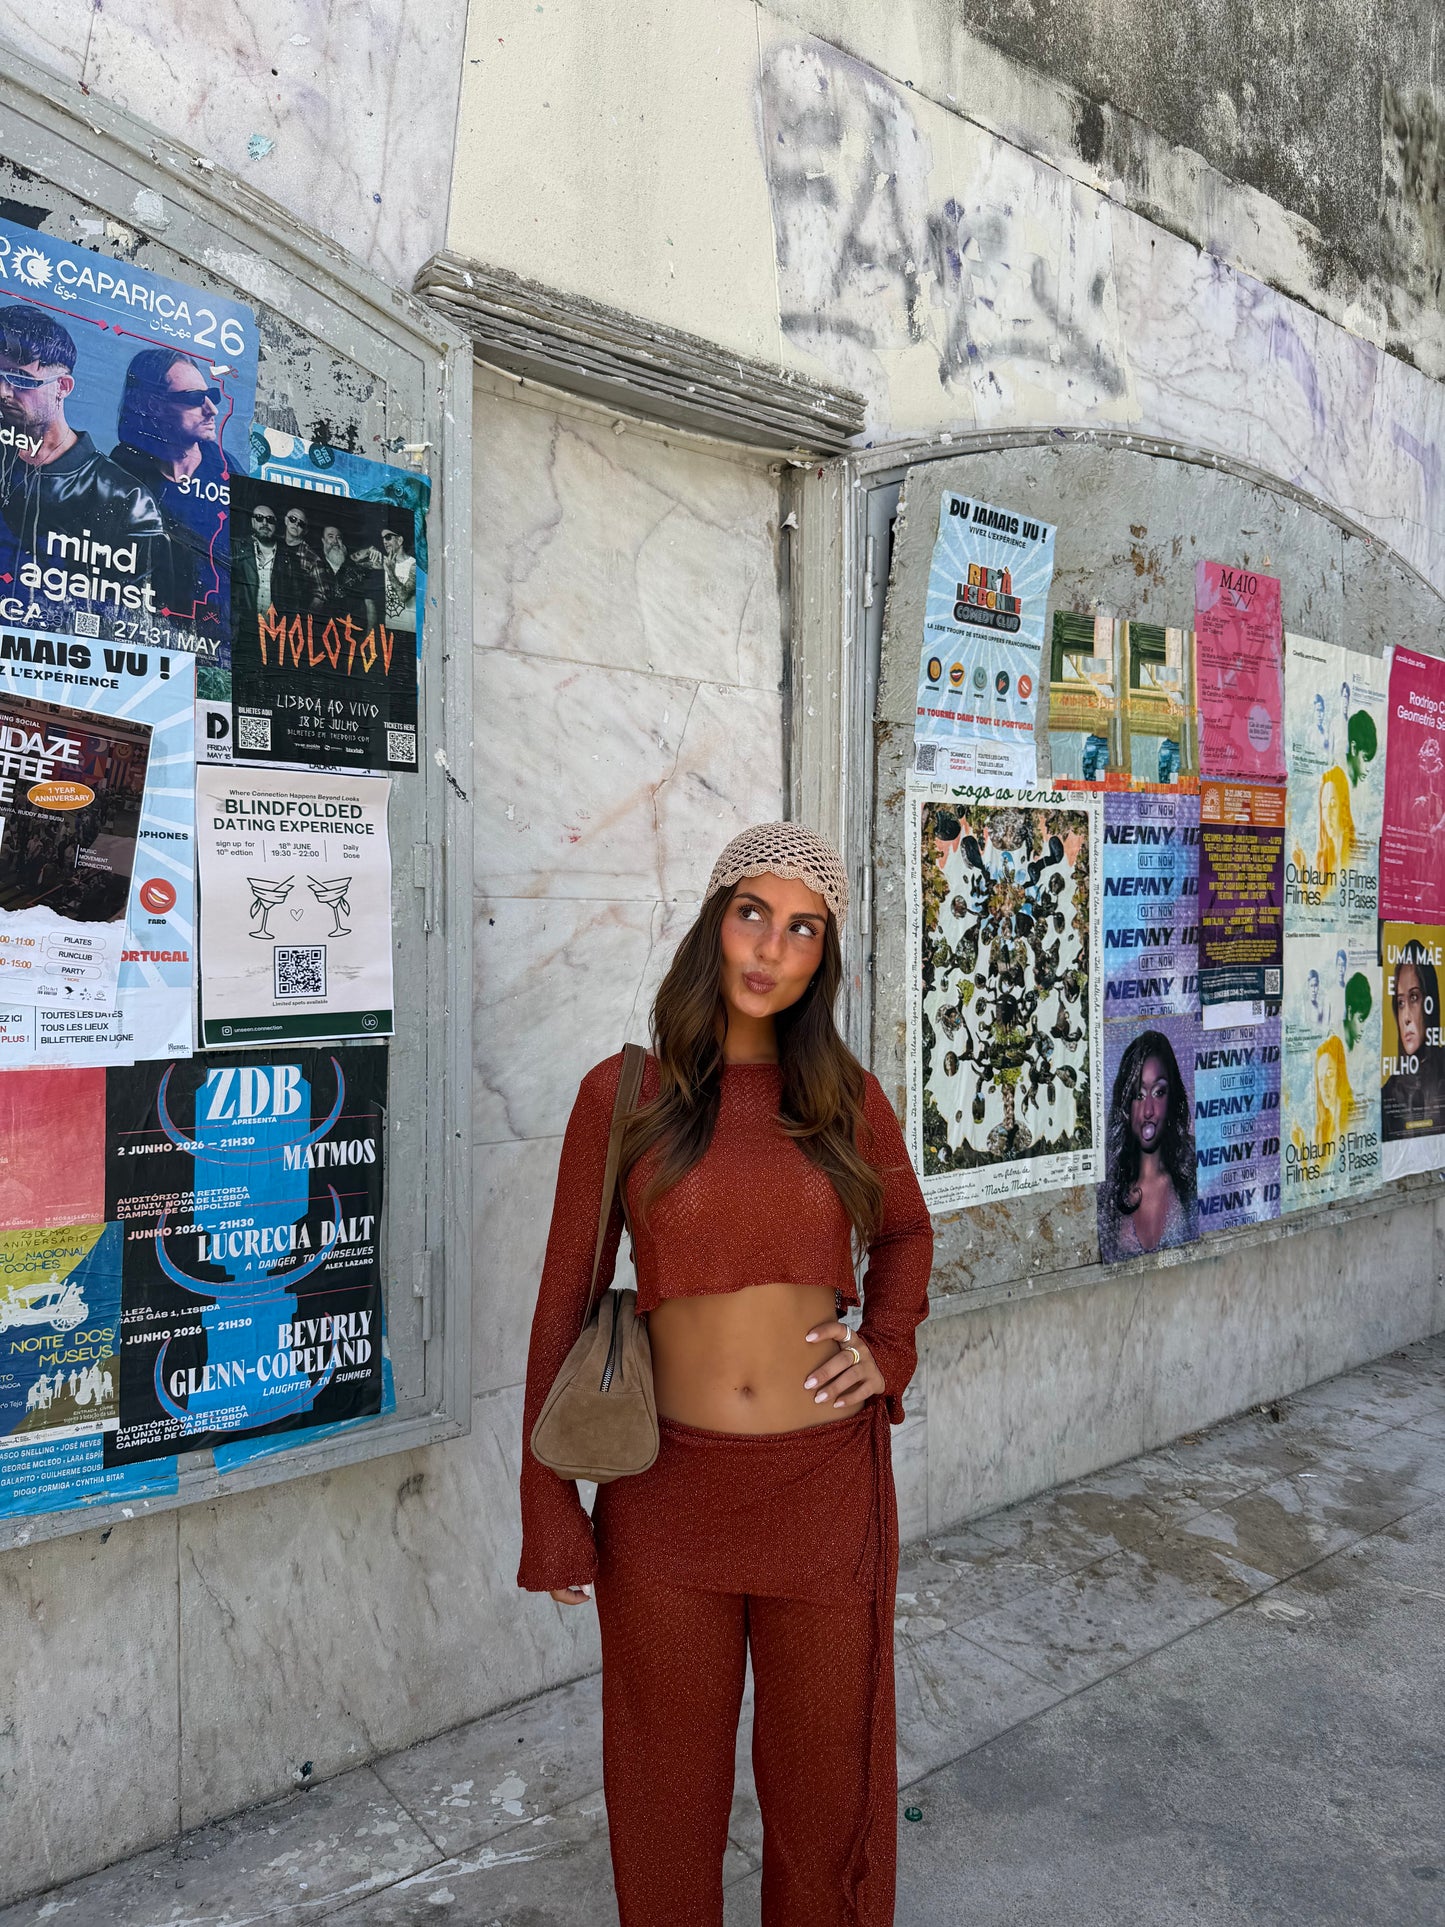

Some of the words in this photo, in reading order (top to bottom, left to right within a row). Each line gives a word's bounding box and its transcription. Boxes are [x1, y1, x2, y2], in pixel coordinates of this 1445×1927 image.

[56, 260, 192, 326] CAPARICA
[194, 308, 245, 356] 26
[178, 474, 230, 505] 31.05
[950, 498, 970, 516] DU
[972, 506, 1019, 536] JAMAIS
[1023, 521, 1039, 540] VU
[969, 526, 987, 537] VIVEZ
[47, 529, 137, 574] mind
[20, 563, 157, 612] against
[1220, 569, 1257, 595] MAIO
[957, 583, 1021, 614] LISBONNE
[956, 605, 994, 625] COMEDY
[995, 613, 1019, 630] CLUB
[178, 632, 221, 655] MAY
[103, 648, 149, 677] VU
[238, 706, 258, 715] BILHETES
[259, 708, 273, 716] AQUI
[277, 694, 321, 717] LISBOA
[328, 700, 344, 717] AO
[349, 702, 379, 719] VIVO
[1410, 692, 1438, 713] Rodrigo
[299, 716, 310, 727] 18
[328, 719, 360, 732] JULHO
[384, 721, 402, 731] TICKETS
[404, 723, 416, 732] HERE
[1397, 706, 1435, 728] Geometria
[34, 794, 90, 802] ANNIVERSARY
[229, 789, 250, 797] Where
[252, 791, 288, 799] Connection
[289, 792, 316, 802] Happens
[318, 794, 340, 803] Beyond
[1018, 788, 1066, 804] vento
[225, 799, 362, 819] BLINDFOLDED
[213, 818, 275, 832] DATING
[280, 820, 375, 835] EXPERIENCE
[1104, 825, 1176, 845] NENNY
[216, 840, 231, 849] sign
[232, 841, 242, 849] up
[244, 840, 256, 848] for
[77, 861, 113, 871] CONNECTION
[1104, 877, 1175, 897] NENNY
[1285, 863, 1337, 886] Oublaum
[1340, 869, 1347, 887] 3
[1349, 869, 1377, 891] Filmes
[1285, 885, 1321, 906] Filmes
[1340, 889, 1347, 907] 3
[1348, 889, 1377, 909] Países
[64, 936, 92, 946] PILATES
[1104, 927, 1175, 948] NENNY
[58, 951, 93, 961] RUNCLUB
[1387, 945, 1413, 965] UMA
[1416, 942, 1442, 966] MÃE
[61, 967, 85, 975] PARTY
[1105, 976, 1174, 1000] NENNY
[1387, 976, 1395, 995] E
[41, 1011, 74, 1019] TOUTES
[1424, 996, 1434, 1015] O
[85, 1022, 109, 1031] LIEUX
[41, 1035, 94, 1044] BILLETTERIE
[1195, 1047, 1256, 1070] NENNY
[1383, 1055, 1419, 1076] FILHO
[206, 1066, 302, 1120] ZDB
[1195, 1095, 1256, 1119] NENNY
[1262, 1092, 1280, 1110] ID
[232, 1116, 277, 1125] APRESENTA
[128, 1143, 172, 1155] JUNHO
[176, 1141, 204, 1151] 2026
[220, 1136, 255, 1146] 21H30
[283, 1139, 375, 1171] MATMOS
[1195, 1141, 1256, 1168] NENNY
[1262, 1137, 1280, 1156] ID
[1286, 1138, 1336, 1164] Oublaum
[1339, 1135, 1346, 1154] 3
[1348, 1129, 1378, 1154] Filmes
[1004, 1168, 1021, 1180] filme
[1286, 1164, 1321, 1186] Filmes
[1339, 1154, 1346, 1174] 3
[117, 1192, 179, 1205] AUDITÓRIO
[197, 1186, 248, 1197] REITORIA
[985, 1184, 1010, 1195] Marta
[1197, 1189, 1256, 1216] NENNY
[1263, 1184, 1280, 1202] ID
[117, 1209, 161, 1220] CAMPUS
[181, 1201, 242, 1213] CAMPOLIDE
[133, 1201, 163, 1211] UNIV.
[166, 1198, 194, 1208] NOVA
[211, 1193, 250, 1202] LISBOA
[128, 1228, 172, 1241] JUNHO
[175, 1224, 203, 1234] 2026
[219, 1218, 254, 1228] 21H30
[198, 1223, 311, 1262] LUCRECIA
[320, 1216, 374, 1246] DALT
[26, 1246, 87, 1261] NACIONAL
[258, 1256, 296, 1269] DANGER
[321, 1246, 374, 1260] OURSELVES
[325, 1262, 343, 1270] ALEX
[345, 1258, 374, 1267] LAZARO
[5, 1259, 60, 1273] COCHES
[146, 1310, 168, 1322] GÁS
[181, 1304, 220, 1316] LISBOA
[126, 1331, 171, 1345] JUNHO
[174, 1326, 202, 1338] 2026
[217, 1318, 252, 1331] 21H30
[278, 1310, 373, 1350] BEVERLY
[10, 1334, 65, 1354] NOITE
[75, 1328, 115, 1345] DOS
[39, 1345, 113, 1367] MUSEUS
[169, 1338, 372, 1398] GLENN-COPELAND
[263, 1379, 311, 1396] LAUGHTER
[335, 1369, 372, 1384] SUMMER
[116, 1417, 178, 1435] AUDITÓRIO
[180, 1414, 194, 1423] DA
[196, 1404, 247, 1420] REITORIA
[132, 1429, 163, 1441] UNIV.
[165, 1423, 193, 1434] NOVA
[210, 1411, 249, 1425] LISBOA
[116, 1437, 161, 1450] CAMPUS
[180, 1420, 241, 1439] CAMPOLIDE
[21, 1446, 54, 1457] SNELLING
[80, 1439, 101, 1448] NEVES
[2, 1463, 31, 1473] GEORGE
[33, 1458, 61, 1469] MCLEOD
[67, 1454, 84, 1463] LARA
[1, 1475, 35, 1487] GALAPITO
[41, 1468, 80, 1480] GUILHERME
[38, 1482, 70, 1493] FORMIGA
[76, 1476, 104, 1487] CYNTHIA
[106, 1473, 124, 1482] BITAR
